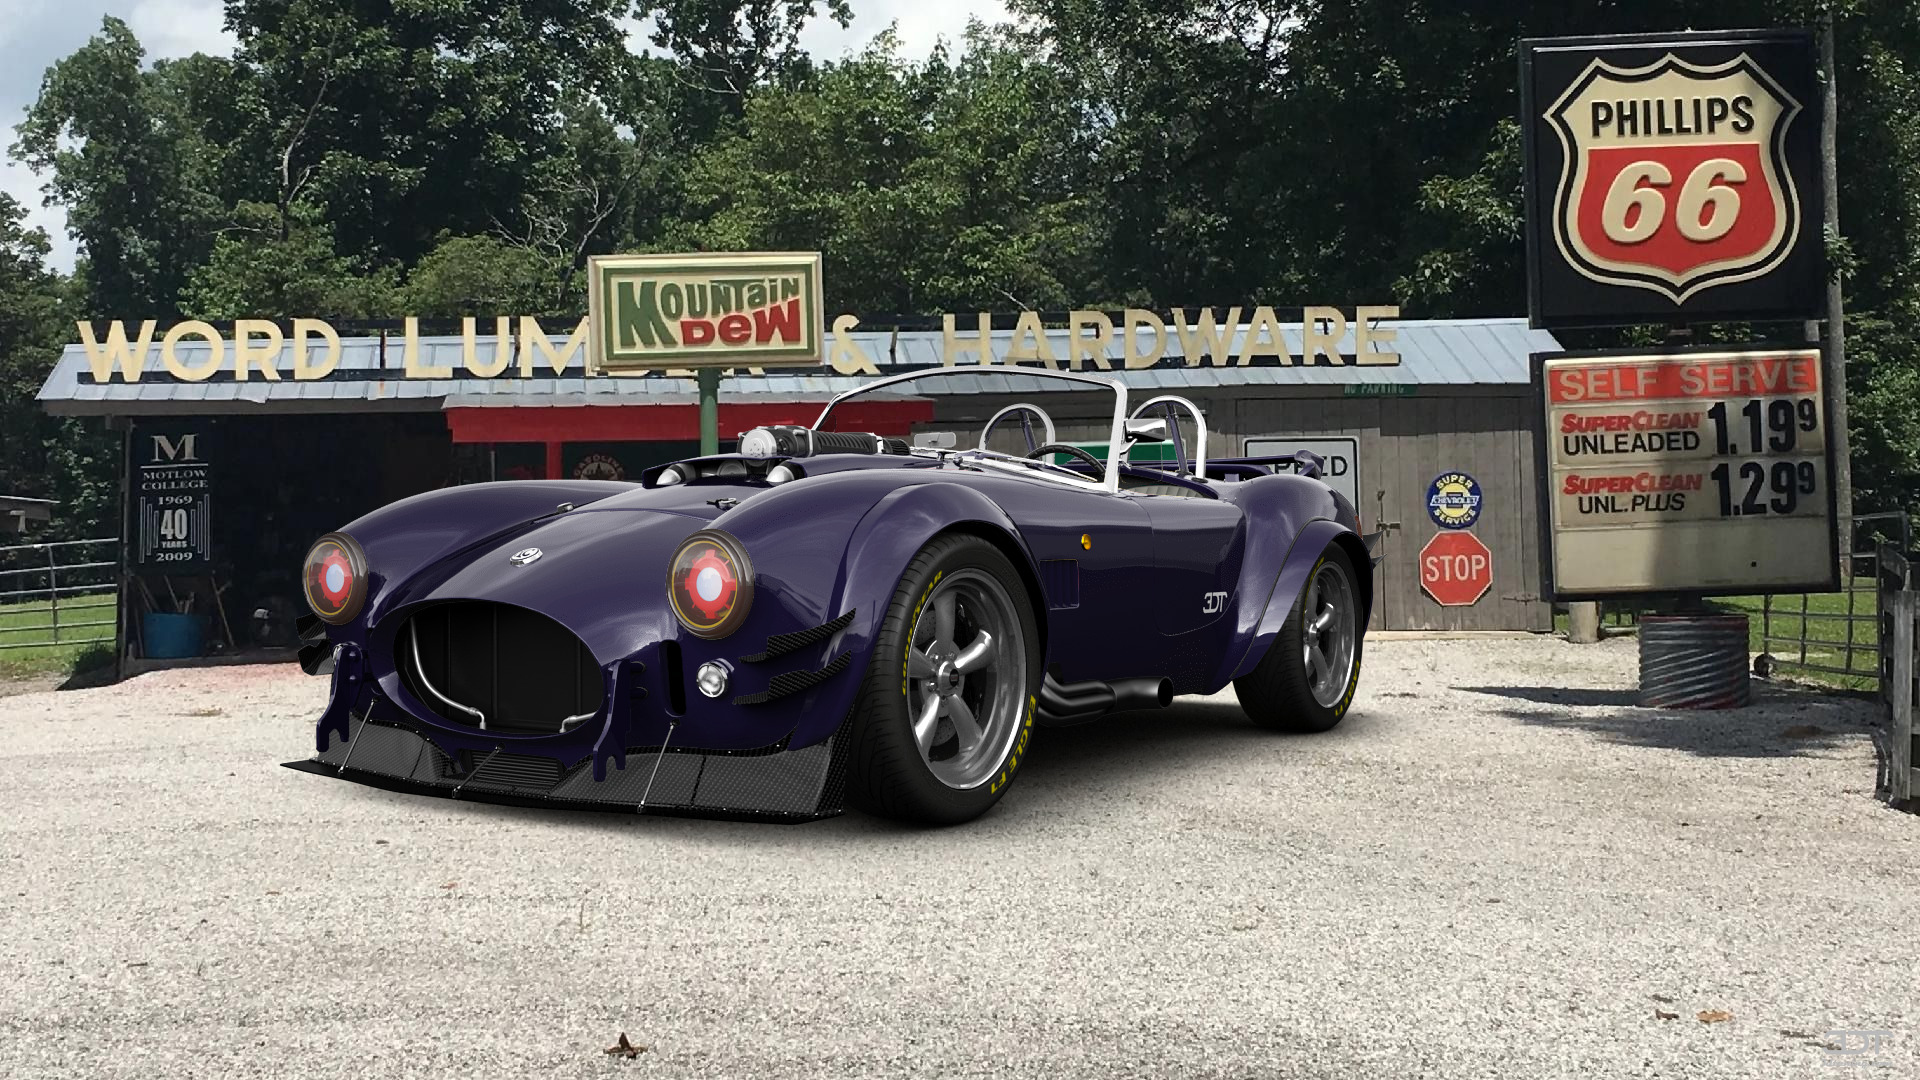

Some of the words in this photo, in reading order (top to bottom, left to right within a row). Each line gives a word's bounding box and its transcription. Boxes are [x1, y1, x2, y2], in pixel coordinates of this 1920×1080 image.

[1591, 95, 1755, 137] PHILLIPS
[1602, 158, 1747, 243] 66
[77, 317, 340, 383] WORD
[830, 314, 881, 375] &
[942, 305, 1402, 369] HARDWARE
[1560, 367, 1657, 400] SELF
[1680, 361, 1809, 395] SERVE
[151, 434, 200, 462] M
[1564, 431, 1700, 456] UNLEADED
[142, 480, 208, 491] COLLEGE
[143, 469, 208, 480] MOTLOW
[1436, 474, 1473, 490] SUPER
[158, 496, 193, 505] 1969
[161, 508, 188, 540] 40
[1433, 508, 1476, 525] SERVICE
[156, 552, 193, 562] 2009
[1426, 555, 1486, 582] STOP
[1009, 694, 1037, 774] EAGLE
[990, 776, 1008, 794] F1
